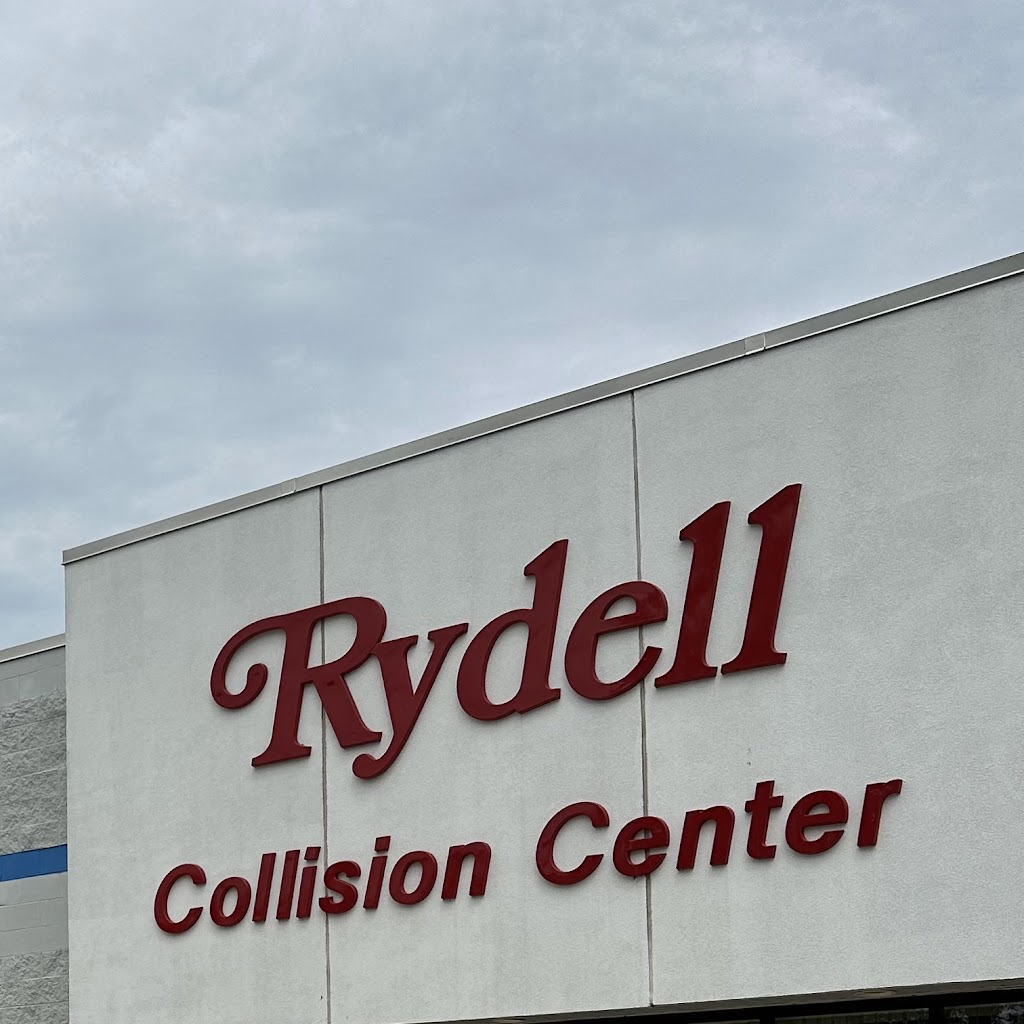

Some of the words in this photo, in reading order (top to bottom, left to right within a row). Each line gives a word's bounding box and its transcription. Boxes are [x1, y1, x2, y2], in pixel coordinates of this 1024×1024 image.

[211, 484, 800, 780] Rydell
[154, 836, 491, 935] Collision
[536, 779, 902, 886] Center
